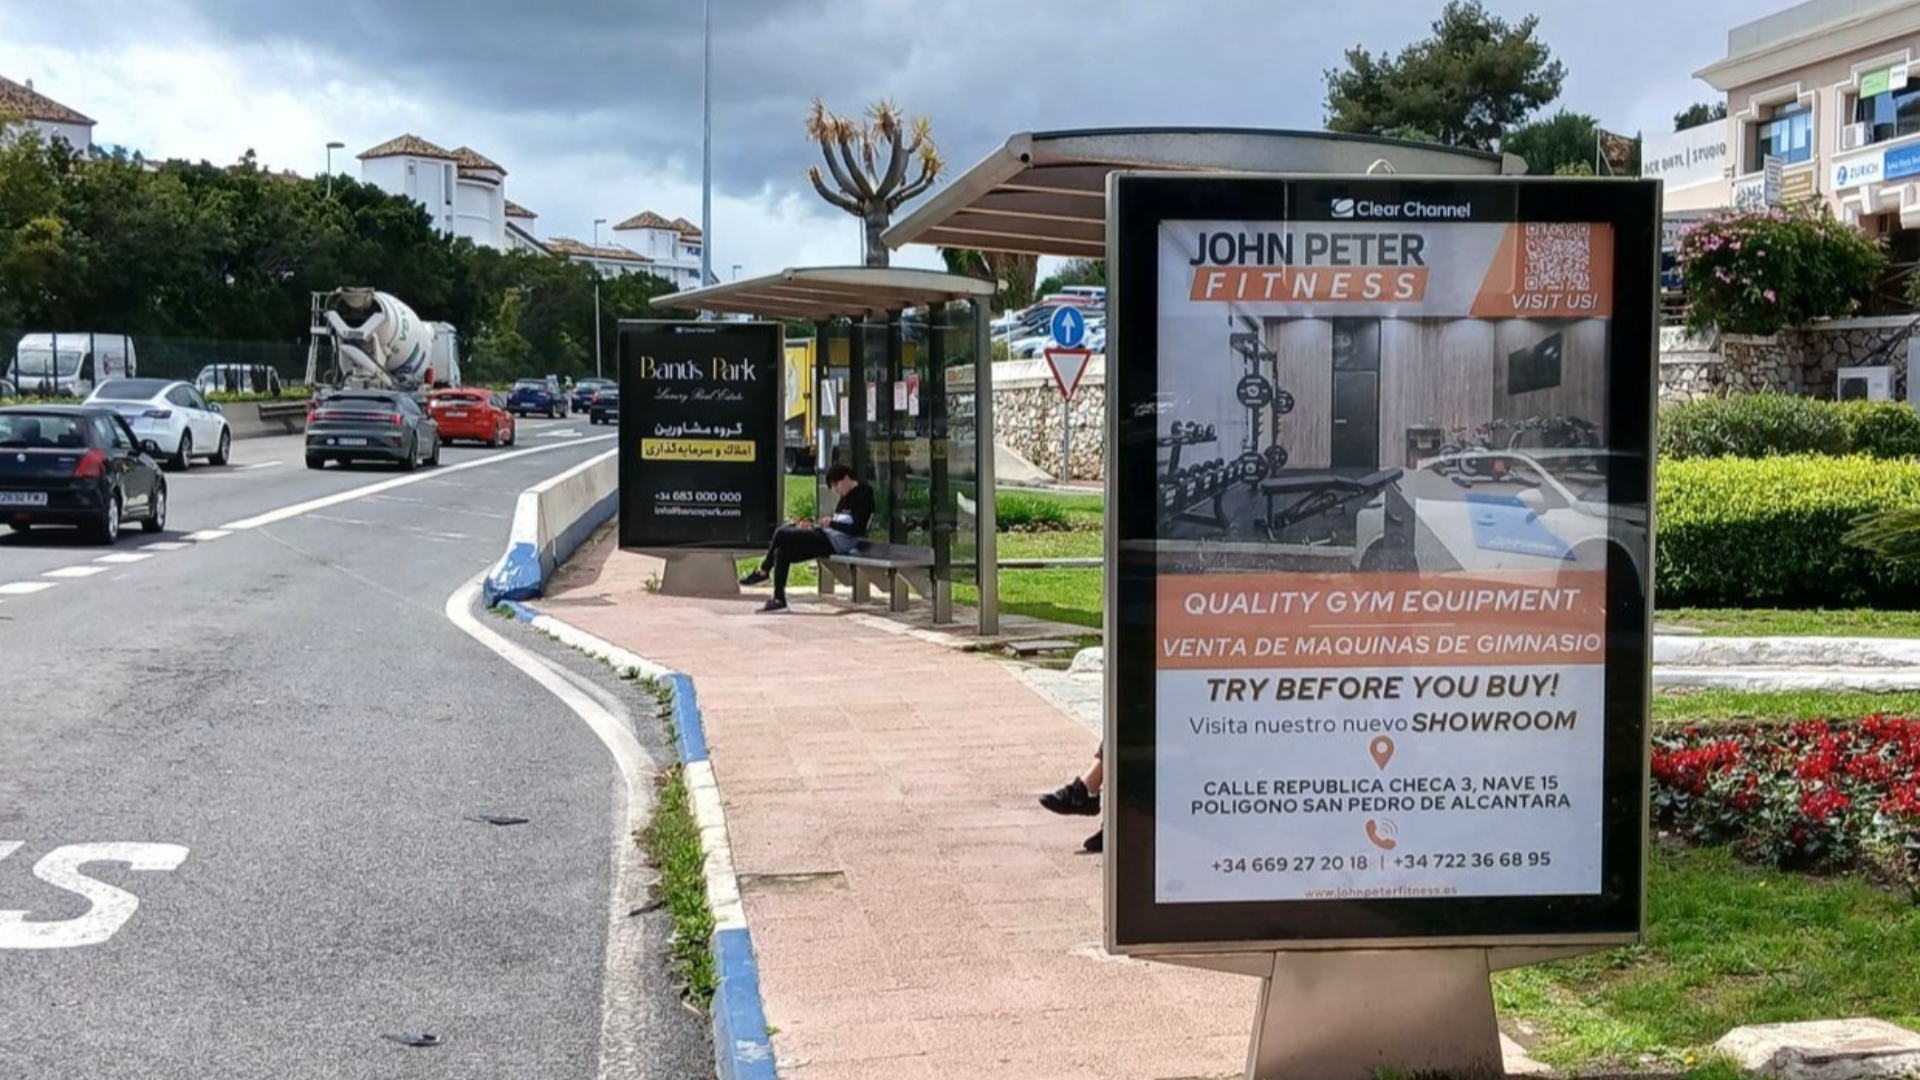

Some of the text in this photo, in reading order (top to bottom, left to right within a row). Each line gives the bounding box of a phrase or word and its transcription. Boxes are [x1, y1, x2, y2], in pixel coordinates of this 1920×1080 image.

[1850, 163, 1879, 179] ZURICH
[1357, 201, 1471, 217] Clear Channel
[1189, 232, 1425, 266] JOHN PETER
[1205, 272, 1416, 299] FITNESS
[1512, 293, 1599, 309] VISIT US!
[712, 357, 756, 381] Park
[655, 491, 671, 501] +34
[695, 491, 718, 502] 000
[719, 491, 742, 503] 000
[1184, 588, 1582, 616] QUALITY GYM EQUIPMENT
[1163, 632, 1602, 658] VENTA DE MAQUINAS DE GIMNASIO
[1206, 672, 1560, 702] TRY BEFORE YOU BUY!
[1188, 709, 1578, 735] Visita nuestro nuevo SHOWROOM
[1203, 774, 1559, 797] CALLE REPUBLICA CHECA 3, NAVE 15
[1190, 793, 1572, 815] POLIGONO SAN PEDRO DE ALCANTARA
[1211, 857, 1247, 873] +34
[1251, 856, 1289, 873] 669
[1292, 856, 1316, 871] 27
[1320, 855, 1344, 871] 20
[1349, 855, 1368, 870] 18
[1393, 854, 1429, 869] +34
[1433, 853, 1467, 869] 722
[1471, 852, 1495, 868] 36
[1499, 851, 1523, 867] 68
[1527, 851, 1552, 866] 95
